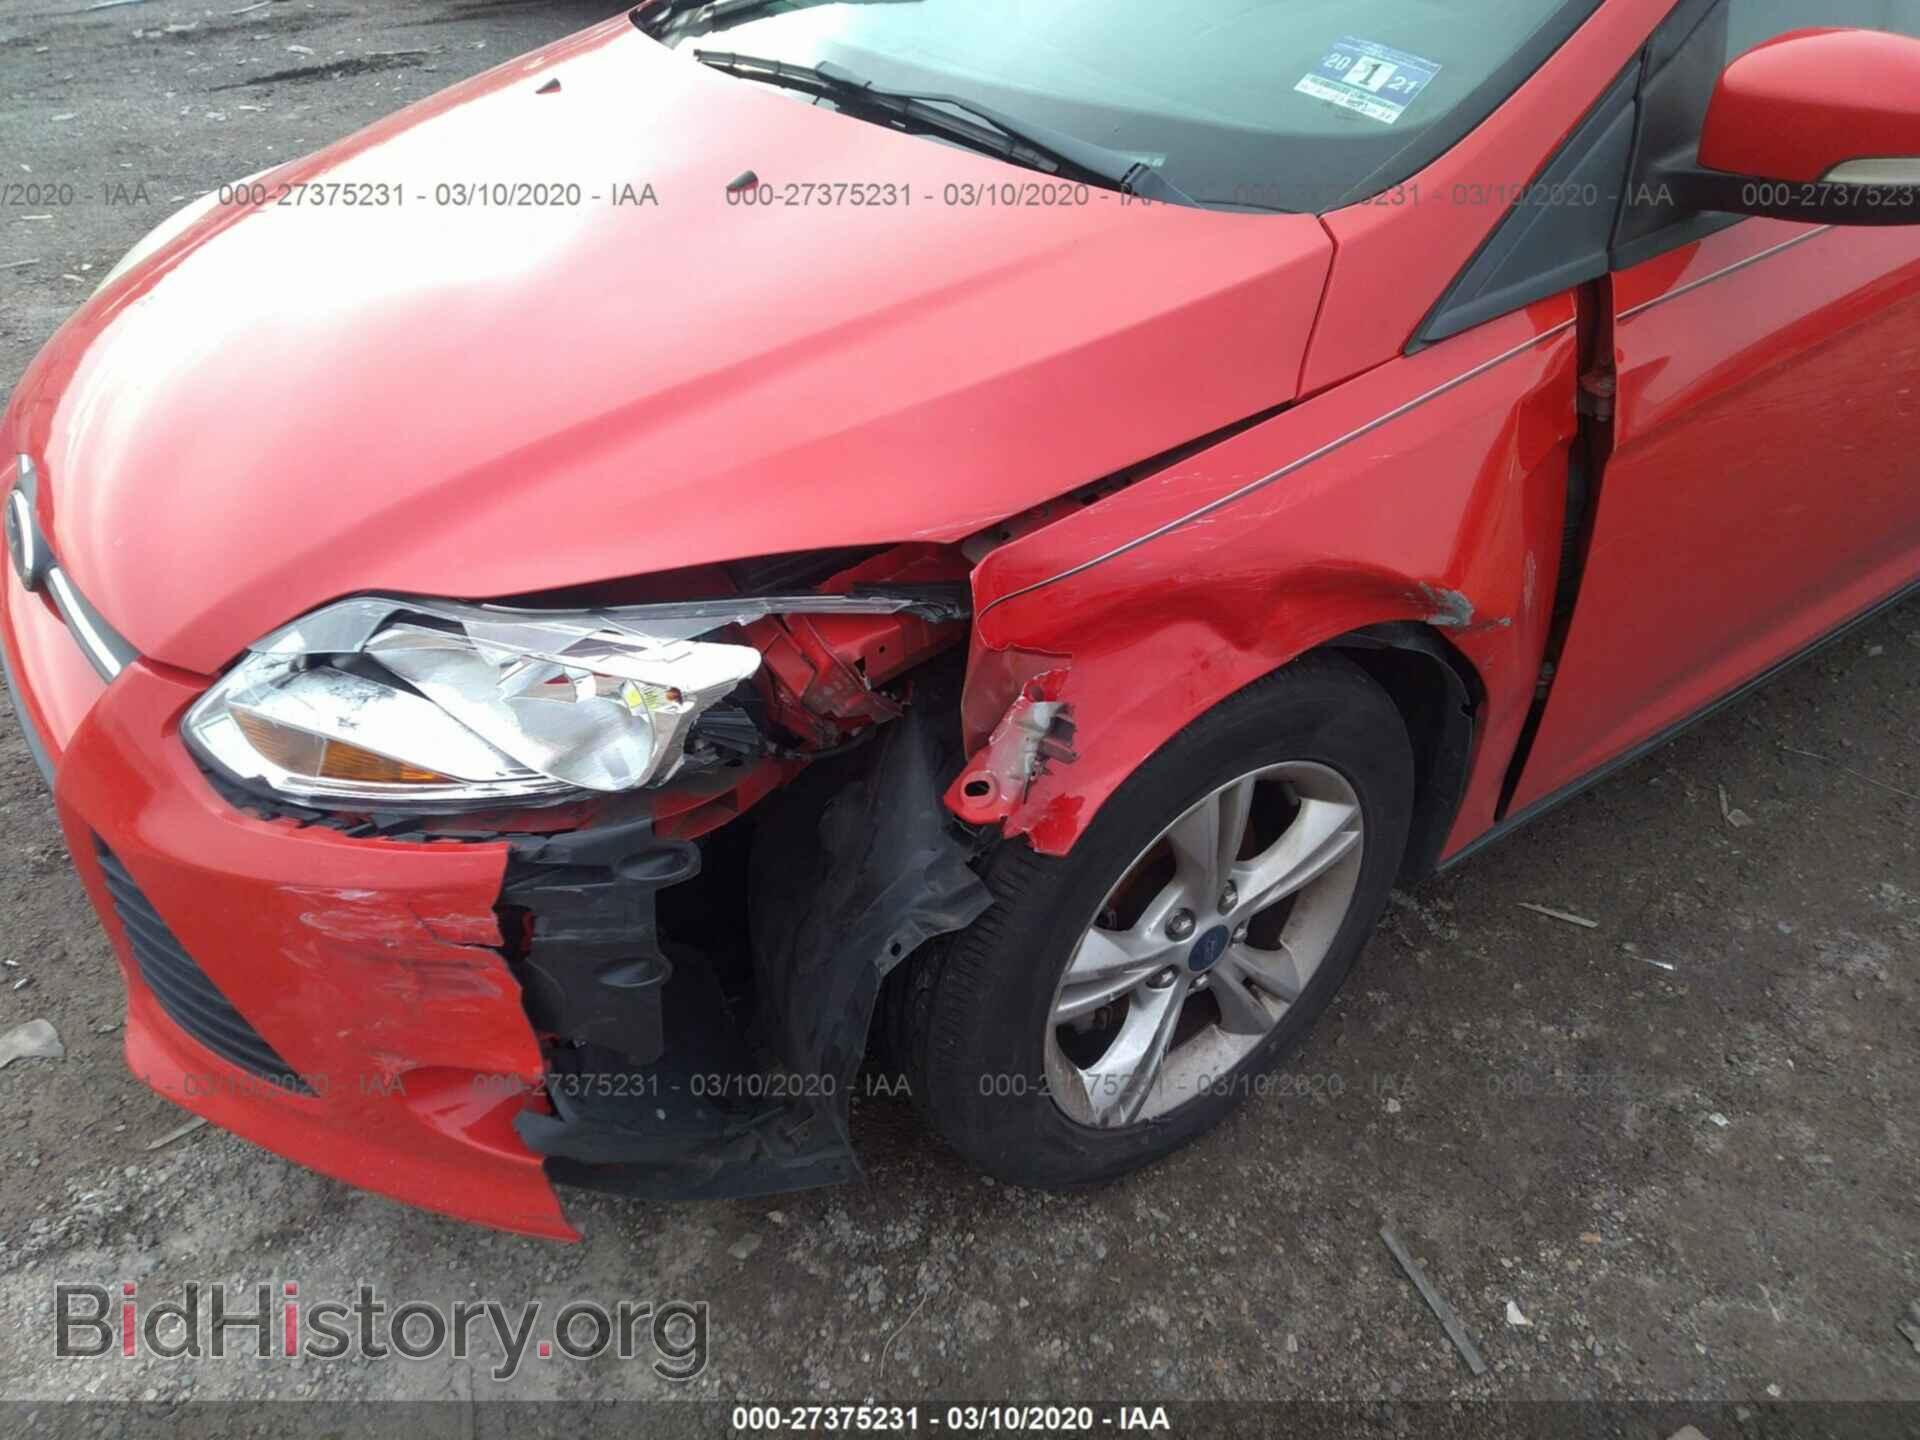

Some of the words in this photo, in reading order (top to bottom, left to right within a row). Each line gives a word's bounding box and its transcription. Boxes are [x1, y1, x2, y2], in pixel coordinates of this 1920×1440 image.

[1323, 52, 1351, 71] 20
[1357, 62, 1383, 86] 1
[1386, 75, 1419, 95] 21
